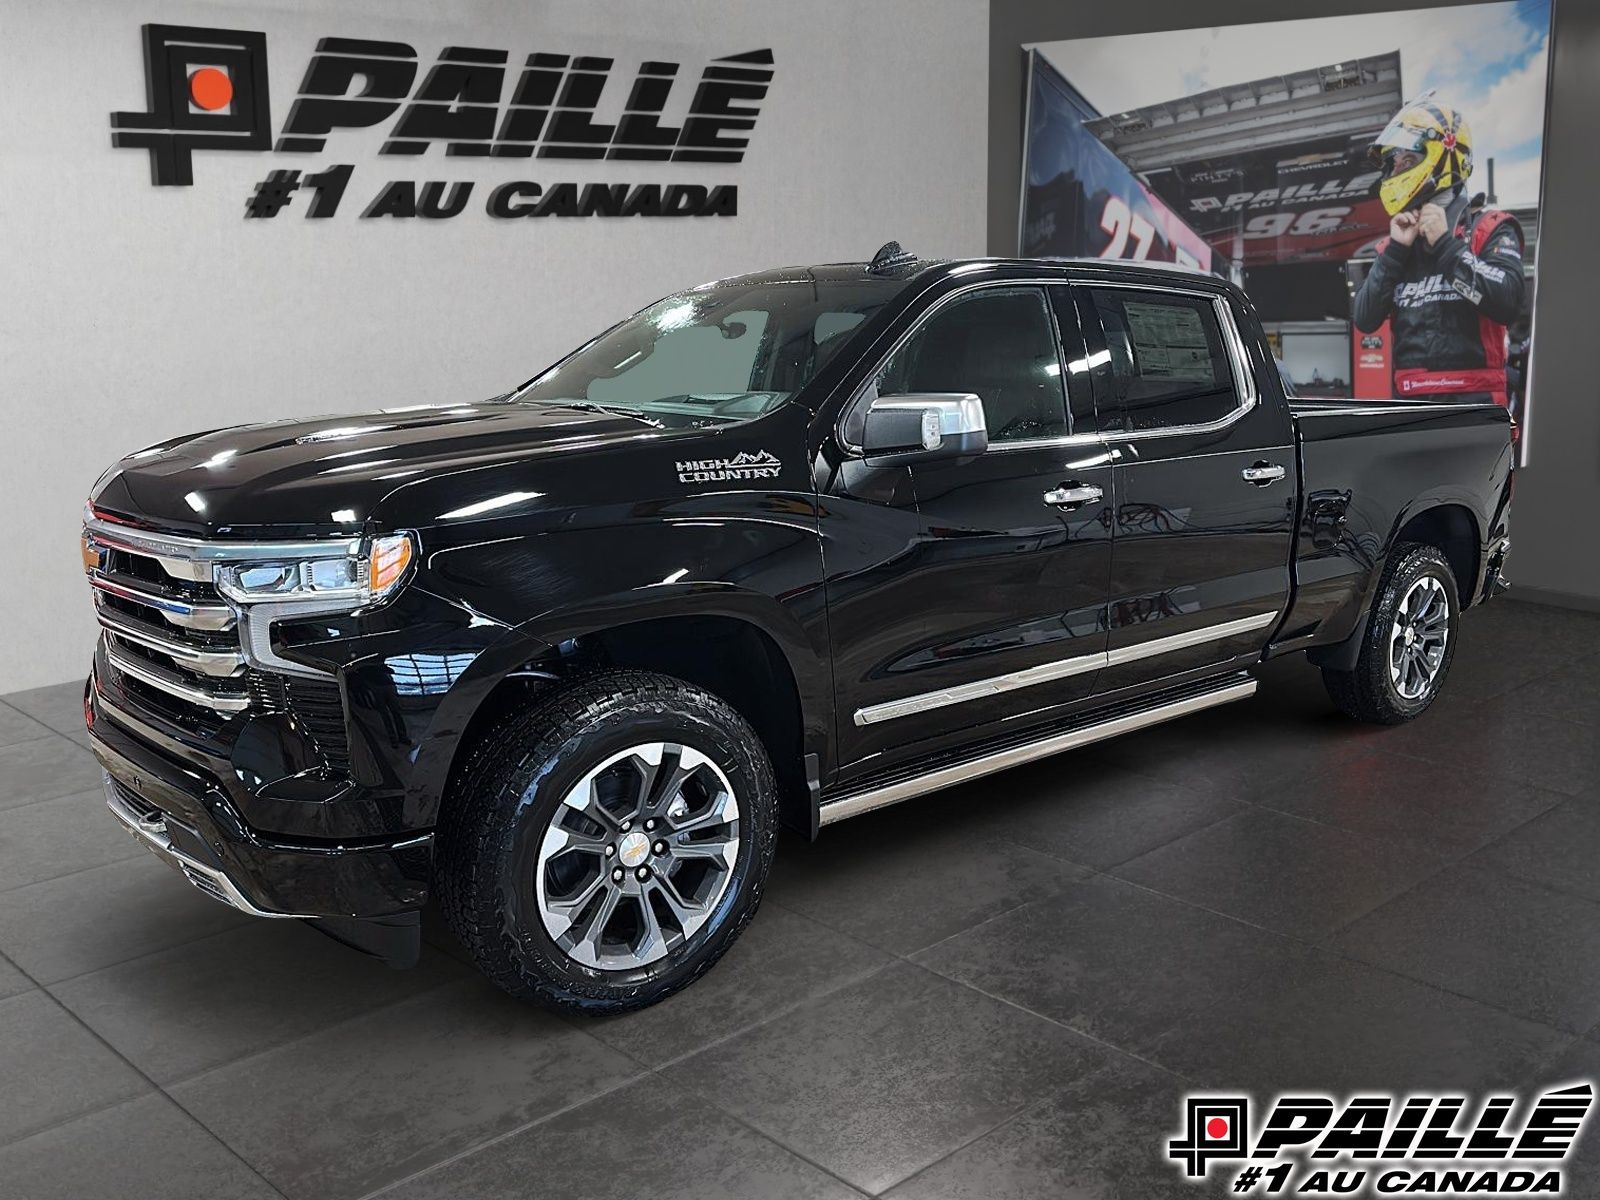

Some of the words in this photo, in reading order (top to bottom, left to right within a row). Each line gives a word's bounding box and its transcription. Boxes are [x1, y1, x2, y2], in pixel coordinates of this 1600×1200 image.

[273, 37, 774, 162] PAILLÉ
[244, 164, 355, 219] #1
[360, 180, 475, 218] AU
[486, 180, 738, 218] CANADA
[1281, 190, 1370, 206] CANADA
[1243, 206, 1352, 239] 96
[675, 459, 729, 472] HIGH
[679, 467, 781, 483] COUNTRY
